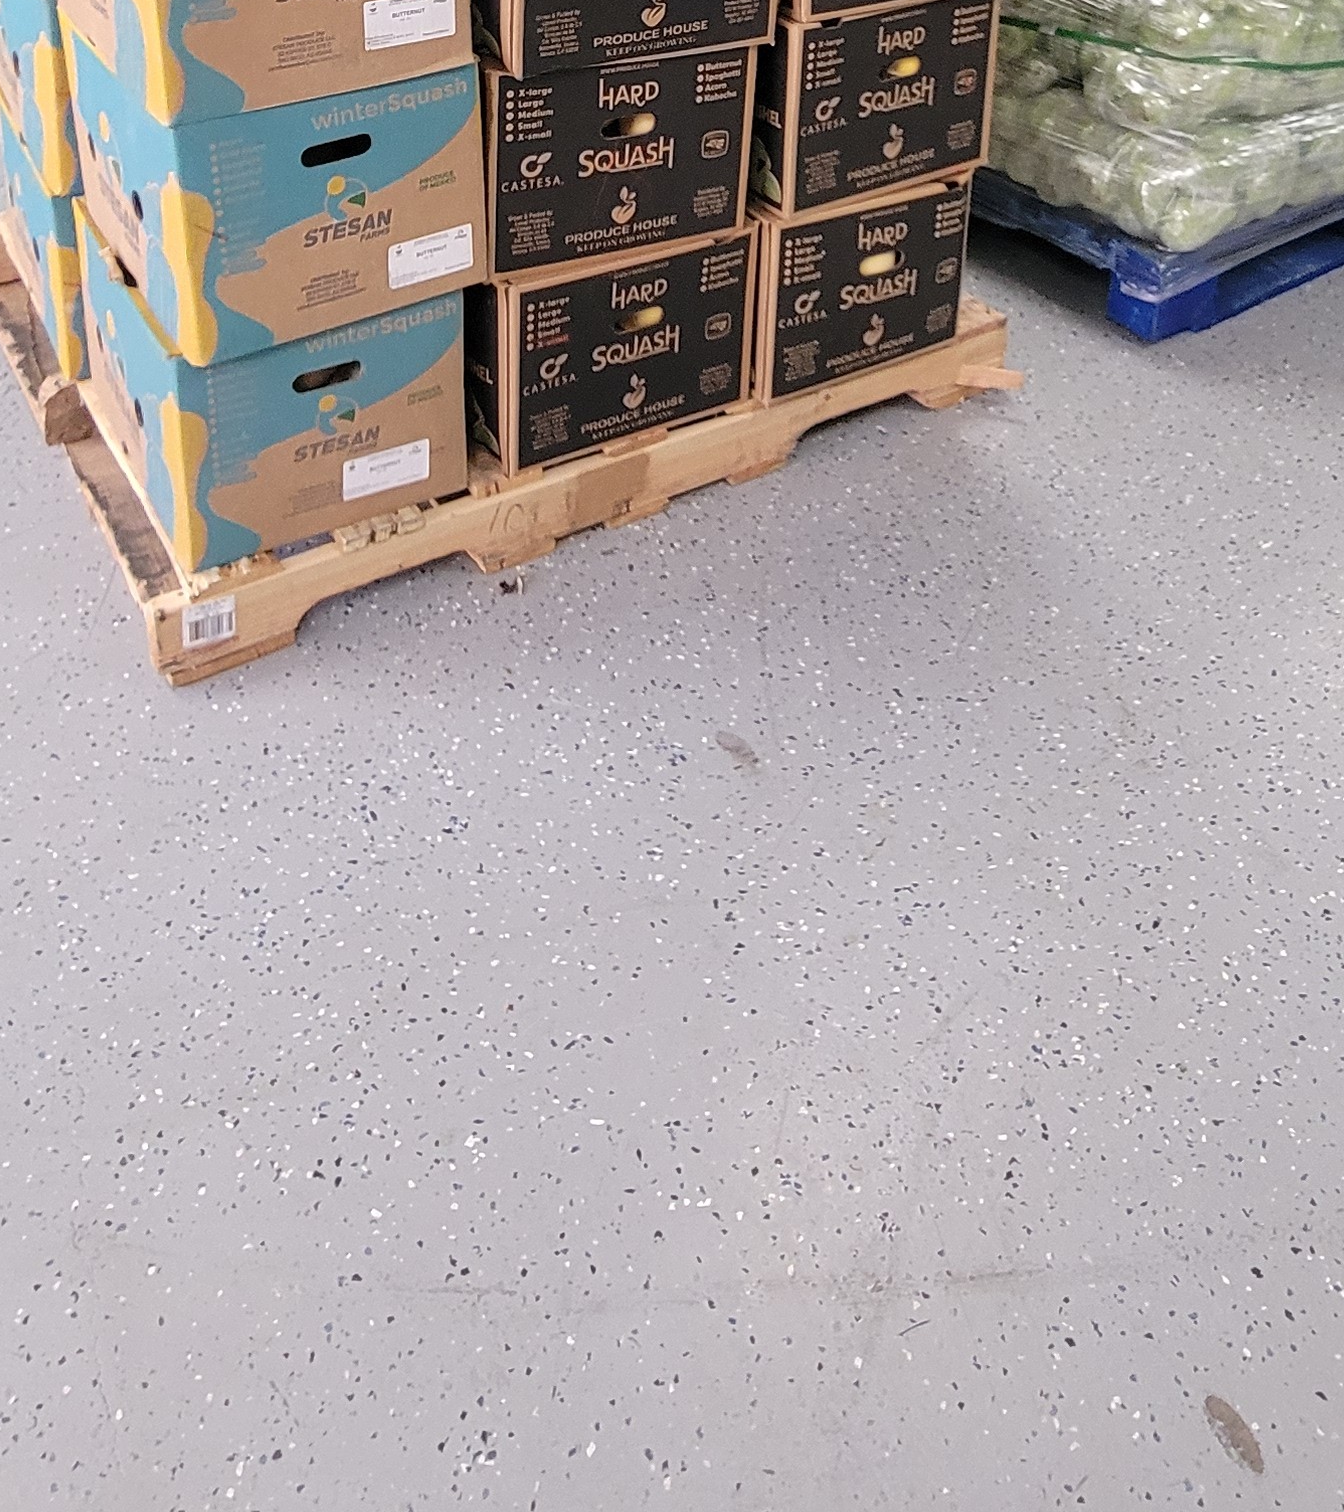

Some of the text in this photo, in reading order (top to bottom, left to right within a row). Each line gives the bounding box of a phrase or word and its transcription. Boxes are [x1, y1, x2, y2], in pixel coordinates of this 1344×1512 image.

[391, 7, 426, 19] BUTTERNUT
[593, 19, 709, 48] PRODUCE HOUSE
[876, 26, 926, 55] HARD
[606, 36, 697, 57] KEEP ON GROWING
[705, 58, 742, 72] Butternut
[705, 69, 741, 83] Spaghetti
[517, 87, 553, 99] X-large
[598, 78, 660, 111] HARD
[703, 90, 738, 103] Kabocha
[704, 82, 728, 92] Acorn
[858, 76, 935, 119] SQUASH
[310, 77, 468, 132] winterSquash
[517, 98, 544, 110] Large
[517, 108, 554, 120] Medium
[517, 120, 543, 131] Small
[517, 130, 552, 142] X-small
[800, 117, 847, 137] CASTESA
[577, 135, 674, 178] SQUASH
[501, 174, 561, 193] CASTESA
[303, 208, 393, 248] STESAN
[360, 226, 391, 243] FARMS
[565, 224, 631, 246] PRODUCE
[633, 214, 678, 232] HOUSE
[858, 222, 908, 251] HARD
[610, 277, 668, 310] HARD
[839, 267, 918, 311] SQUASH
[304, 298, 457, 355] winterSquash
[778, 310, 827, 330] CASTESA
[591, 324, 680, 372] SQUASH
[523, 372, 577, 397] CASTESA
[581, 409, 641, 435] PRODUCE
[643, 393, 686, 415] HOUSE
[294, 425, 381, 463] STESAN
